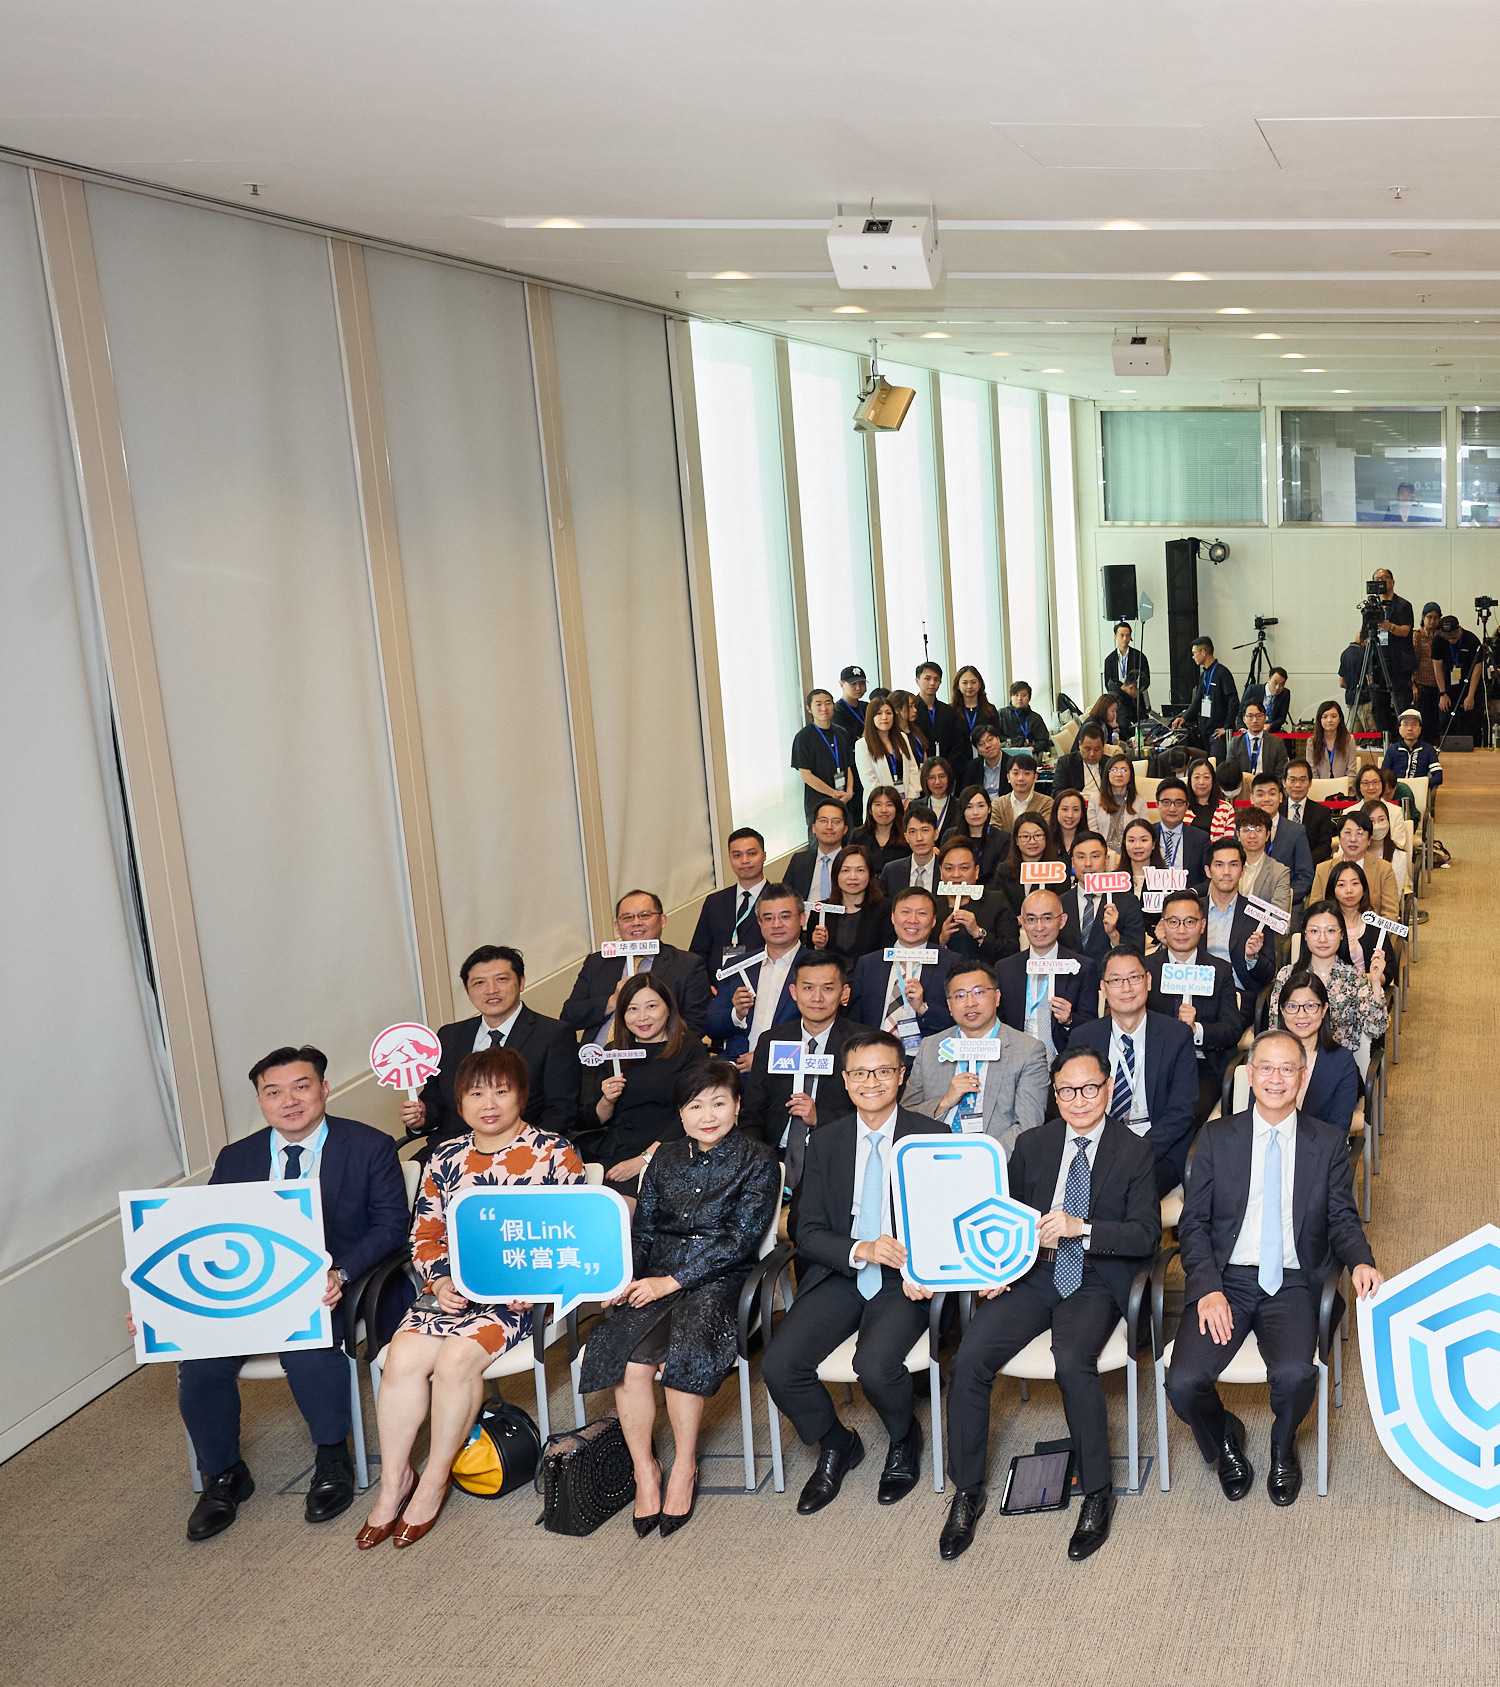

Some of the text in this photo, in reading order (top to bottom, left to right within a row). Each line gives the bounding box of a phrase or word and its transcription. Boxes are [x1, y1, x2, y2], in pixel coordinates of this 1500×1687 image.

[1022, 863, 1066, 883] LWB
[1086, 872, 1130, 892] KMB
[1144, 867, 1186, 889] Veeko
[939, 881, 982, 899] kkday
[619, 941, 658, 951] 华泰国际
[1163, 965, 1198, 981] SoFi
[1162, 982, 1213, 994] Hong Kong
[773, 1057, 796, 1069] AXA
[805, 1057, 829, 1069] 安盛
[380, 1063, 438, 1088] AIA
[500, 1219, 576, 1241] 假Link
